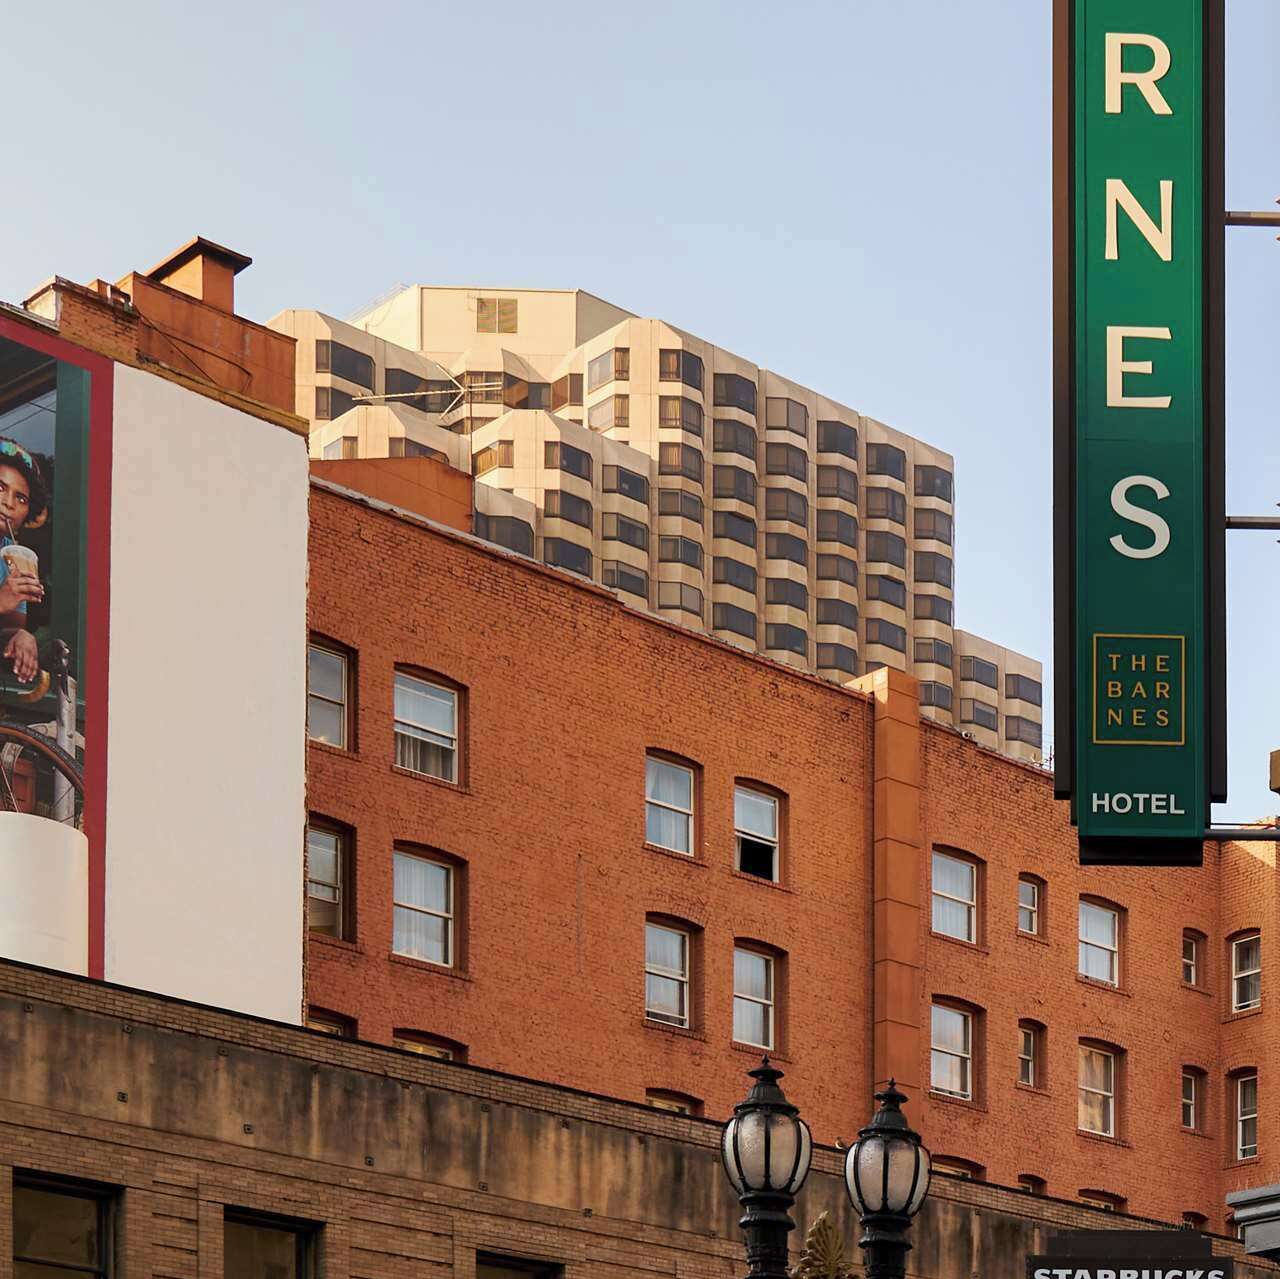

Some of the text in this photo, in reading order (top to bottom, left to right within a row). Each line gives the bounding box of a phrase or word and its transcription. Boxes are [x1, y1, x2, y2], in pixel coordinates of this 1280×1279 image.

[1108, 654, 1170, 672] THE
[1108, 681, 1170, 698] BAR
[1108, 709, 1170, 726] NES
[1092, 792, 1185, 815] HOTEL
